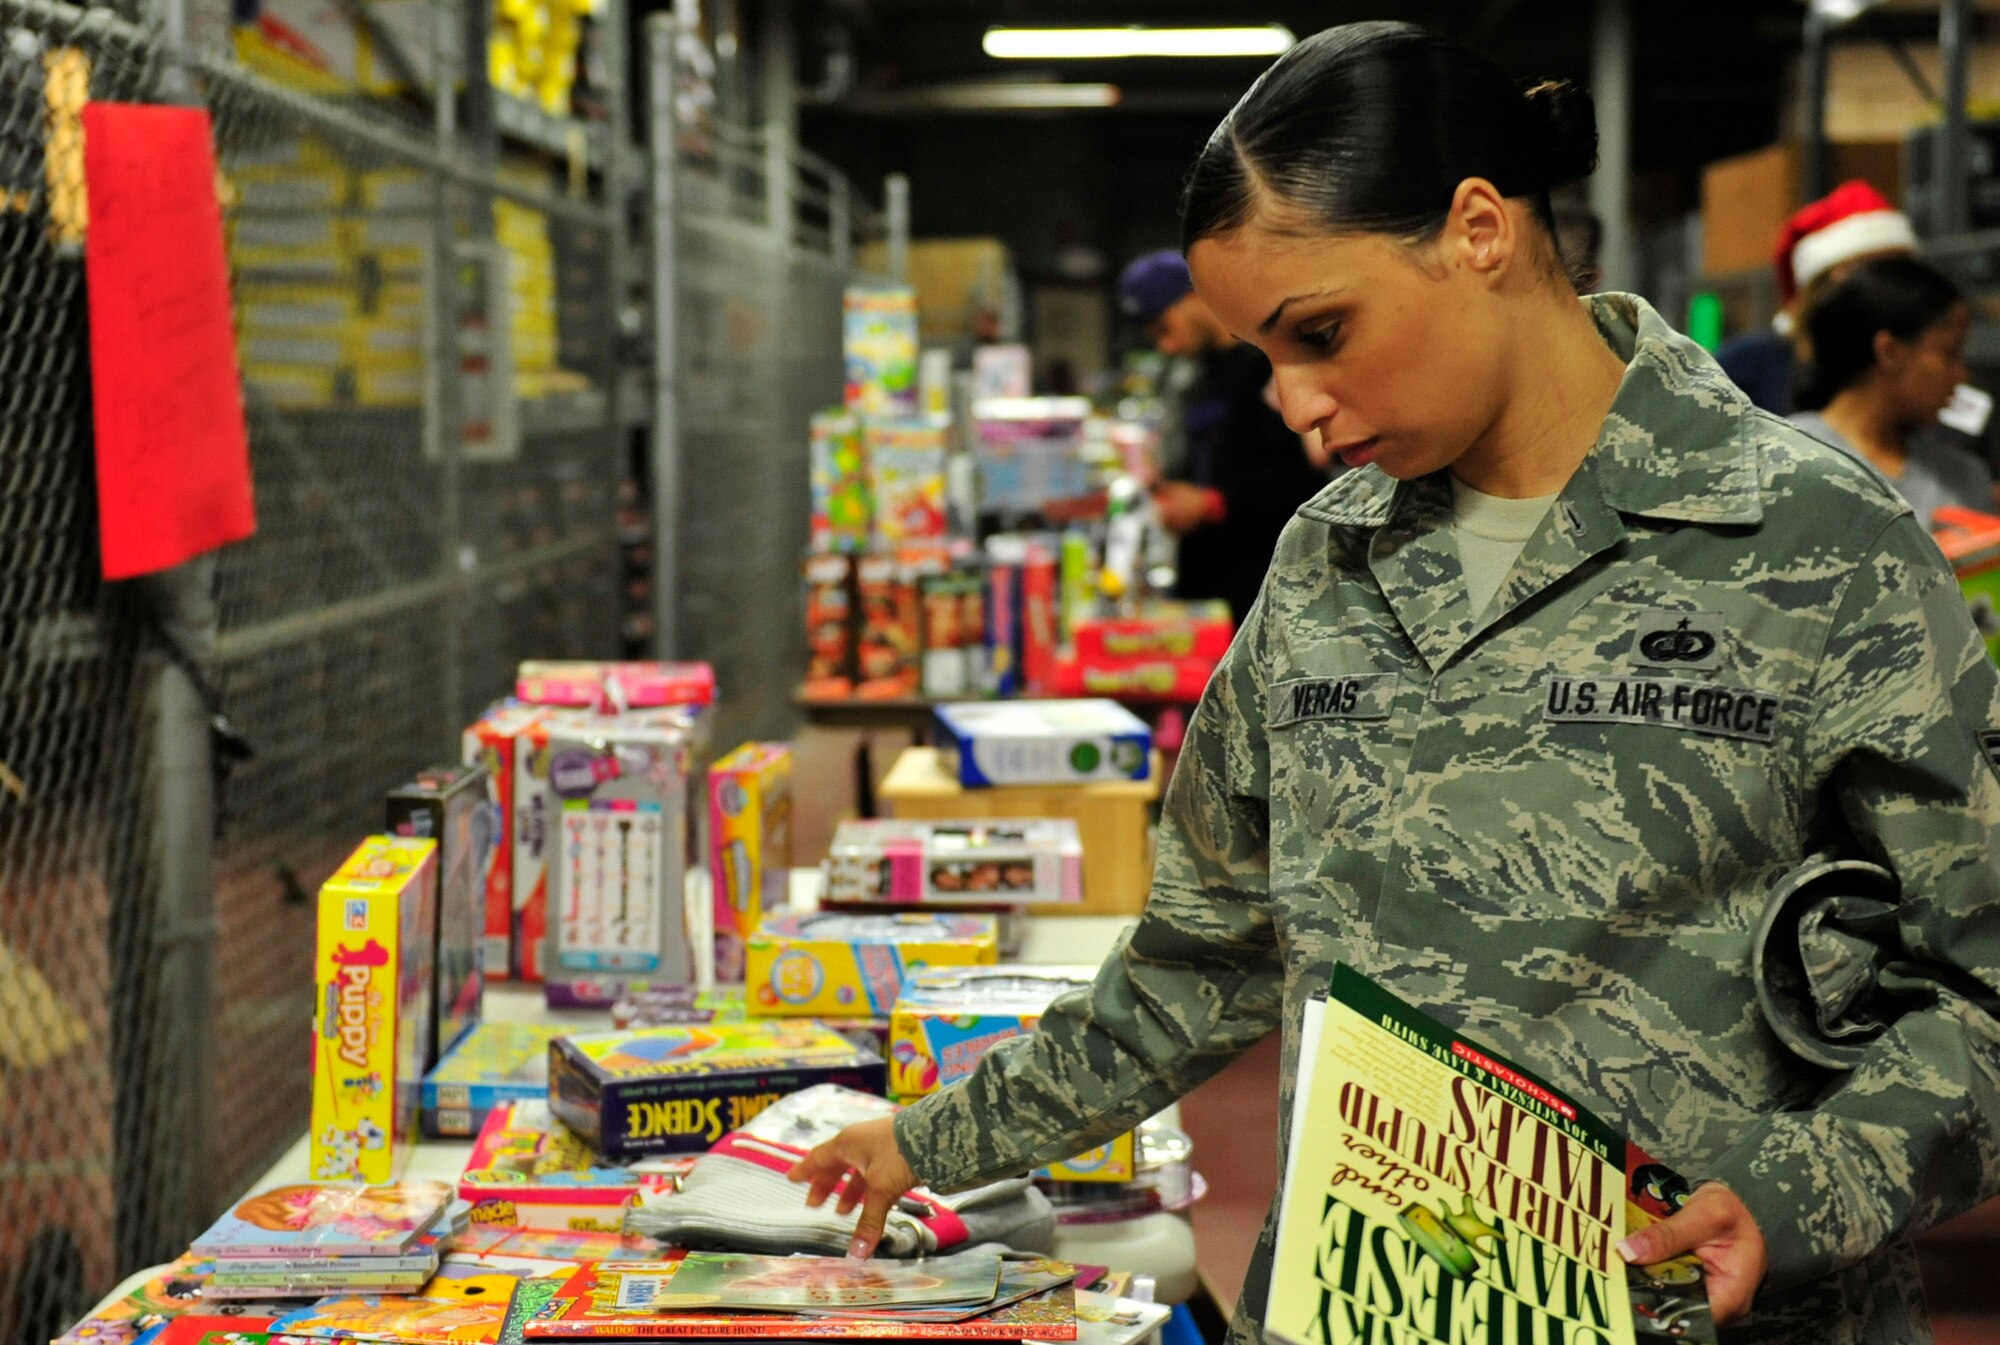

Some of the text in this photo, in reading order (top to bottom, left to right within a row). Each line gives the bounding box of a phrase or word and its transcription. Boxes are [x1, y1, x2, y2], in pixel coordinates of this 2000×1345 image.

[1292, 680, 1360, 718] VERAS
[1547, 681, 1778, 736] U.S. AIR FORCE
[1380, 1013, 1609, 1159] BY JON SCIESZKA & LANE SMITH
[1454, 1044, 1559, 1110] SCHOLASTIC
[626, 1097, 724, 1143] SCIENCE
[1338, 1081, 1610, 1280] FAIRLY STUPID
[1341, 1132, 1430, 1192] other
[1449, 1075, 1613, 1229] TALES
[1331, 1162, 1403, 1206] and
[1314, 1193, 1614, 1345] HEESE
[637, 1325, 655, 1335] THE
[657, 1324, 688, 1335] GREAT
[690, 1324, 731, 1335] PICTURE
[732, 1324, 766, 1335] HUNT!
